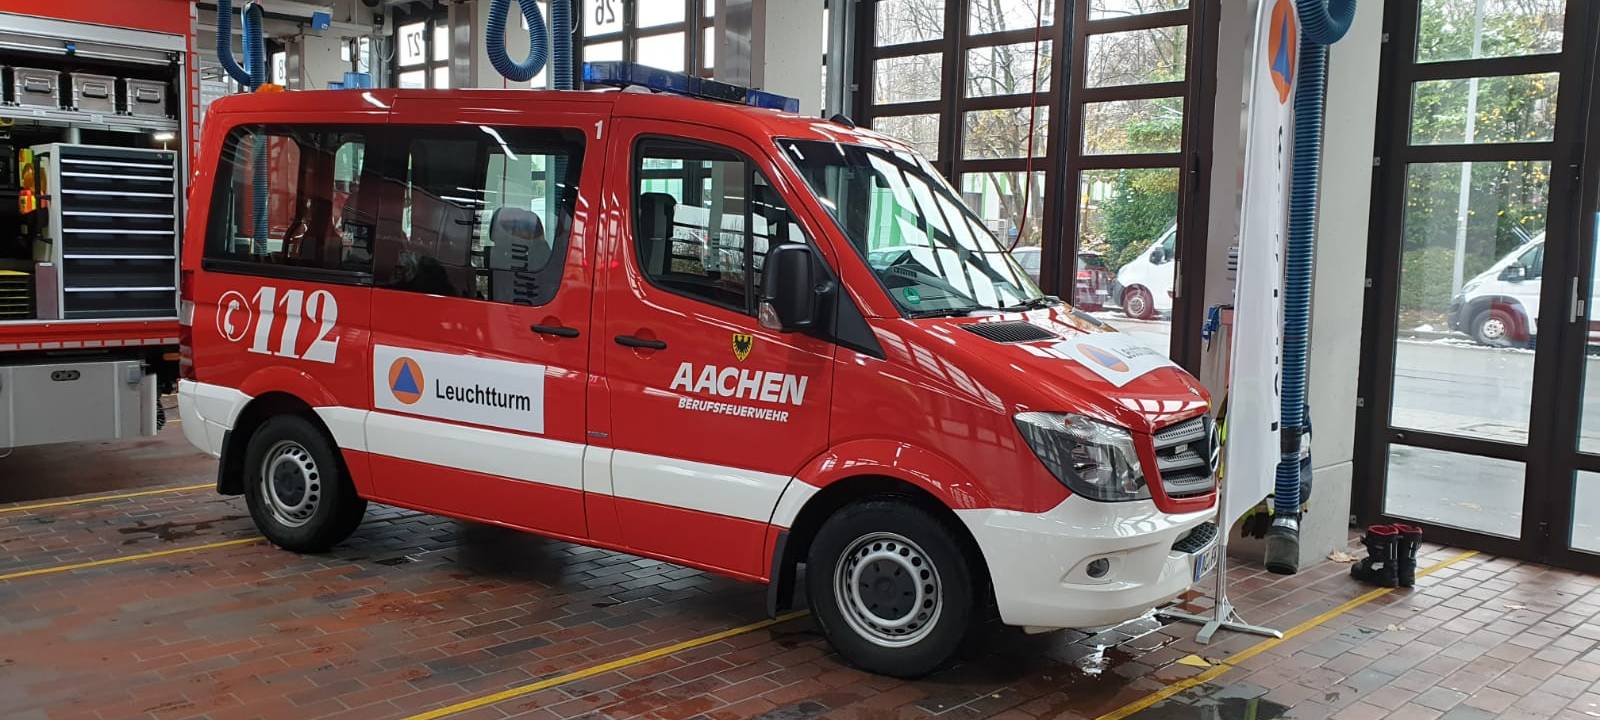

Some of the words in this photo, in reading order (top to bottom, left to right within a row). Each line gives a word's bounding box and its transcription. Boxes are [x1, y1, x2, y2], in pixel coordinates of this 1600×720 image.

[594, 119, 603, 140] 1
[788, 144, 805, 160] 1
[247, 286, 340, 364] 112
[435, 378, 531, 412] Leuchtturm
[669, 361, 809, 406] AACHEN
[677, 398, 790, 423] BERUFSFEUERWEHR
